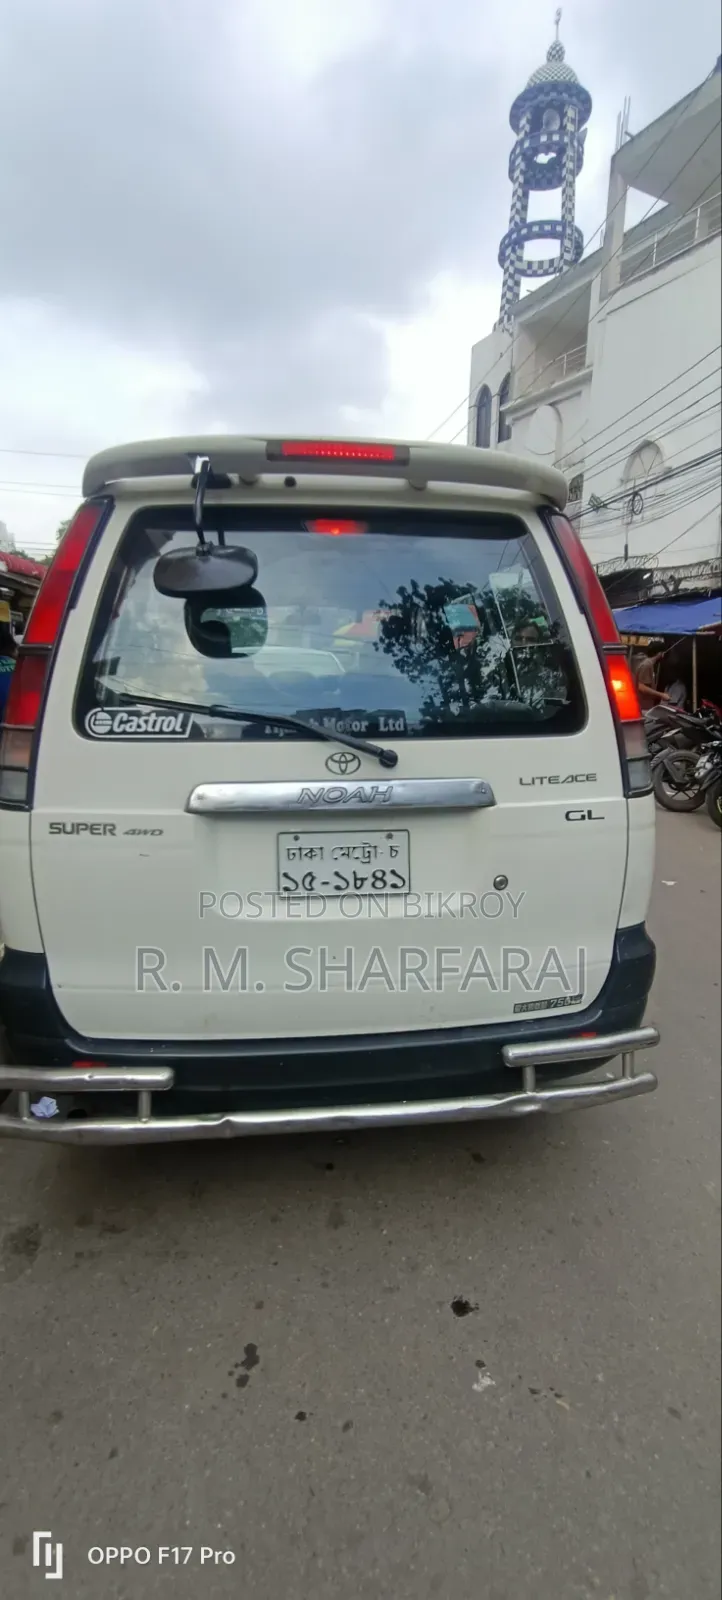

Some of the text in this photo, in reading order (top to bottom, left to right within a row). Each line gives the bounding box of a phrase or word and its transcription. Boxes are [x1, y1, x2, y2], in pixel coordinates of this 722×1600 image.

[112, 712, 183, 733] Castrol
[378, 716, 405, 732] Ltd
[519, 772, 598, 786] LITEACE
[296, 785, 394, 804] NOAH
[564, 809, 606, 822] GL
[48, 822, 164, 836] SUPER 4WD
[286, 846, 325, 861] ঢাকা
[388, 845, 401, 858] চ
[282, 869, 406, 892] ১৫-১৮৪১
